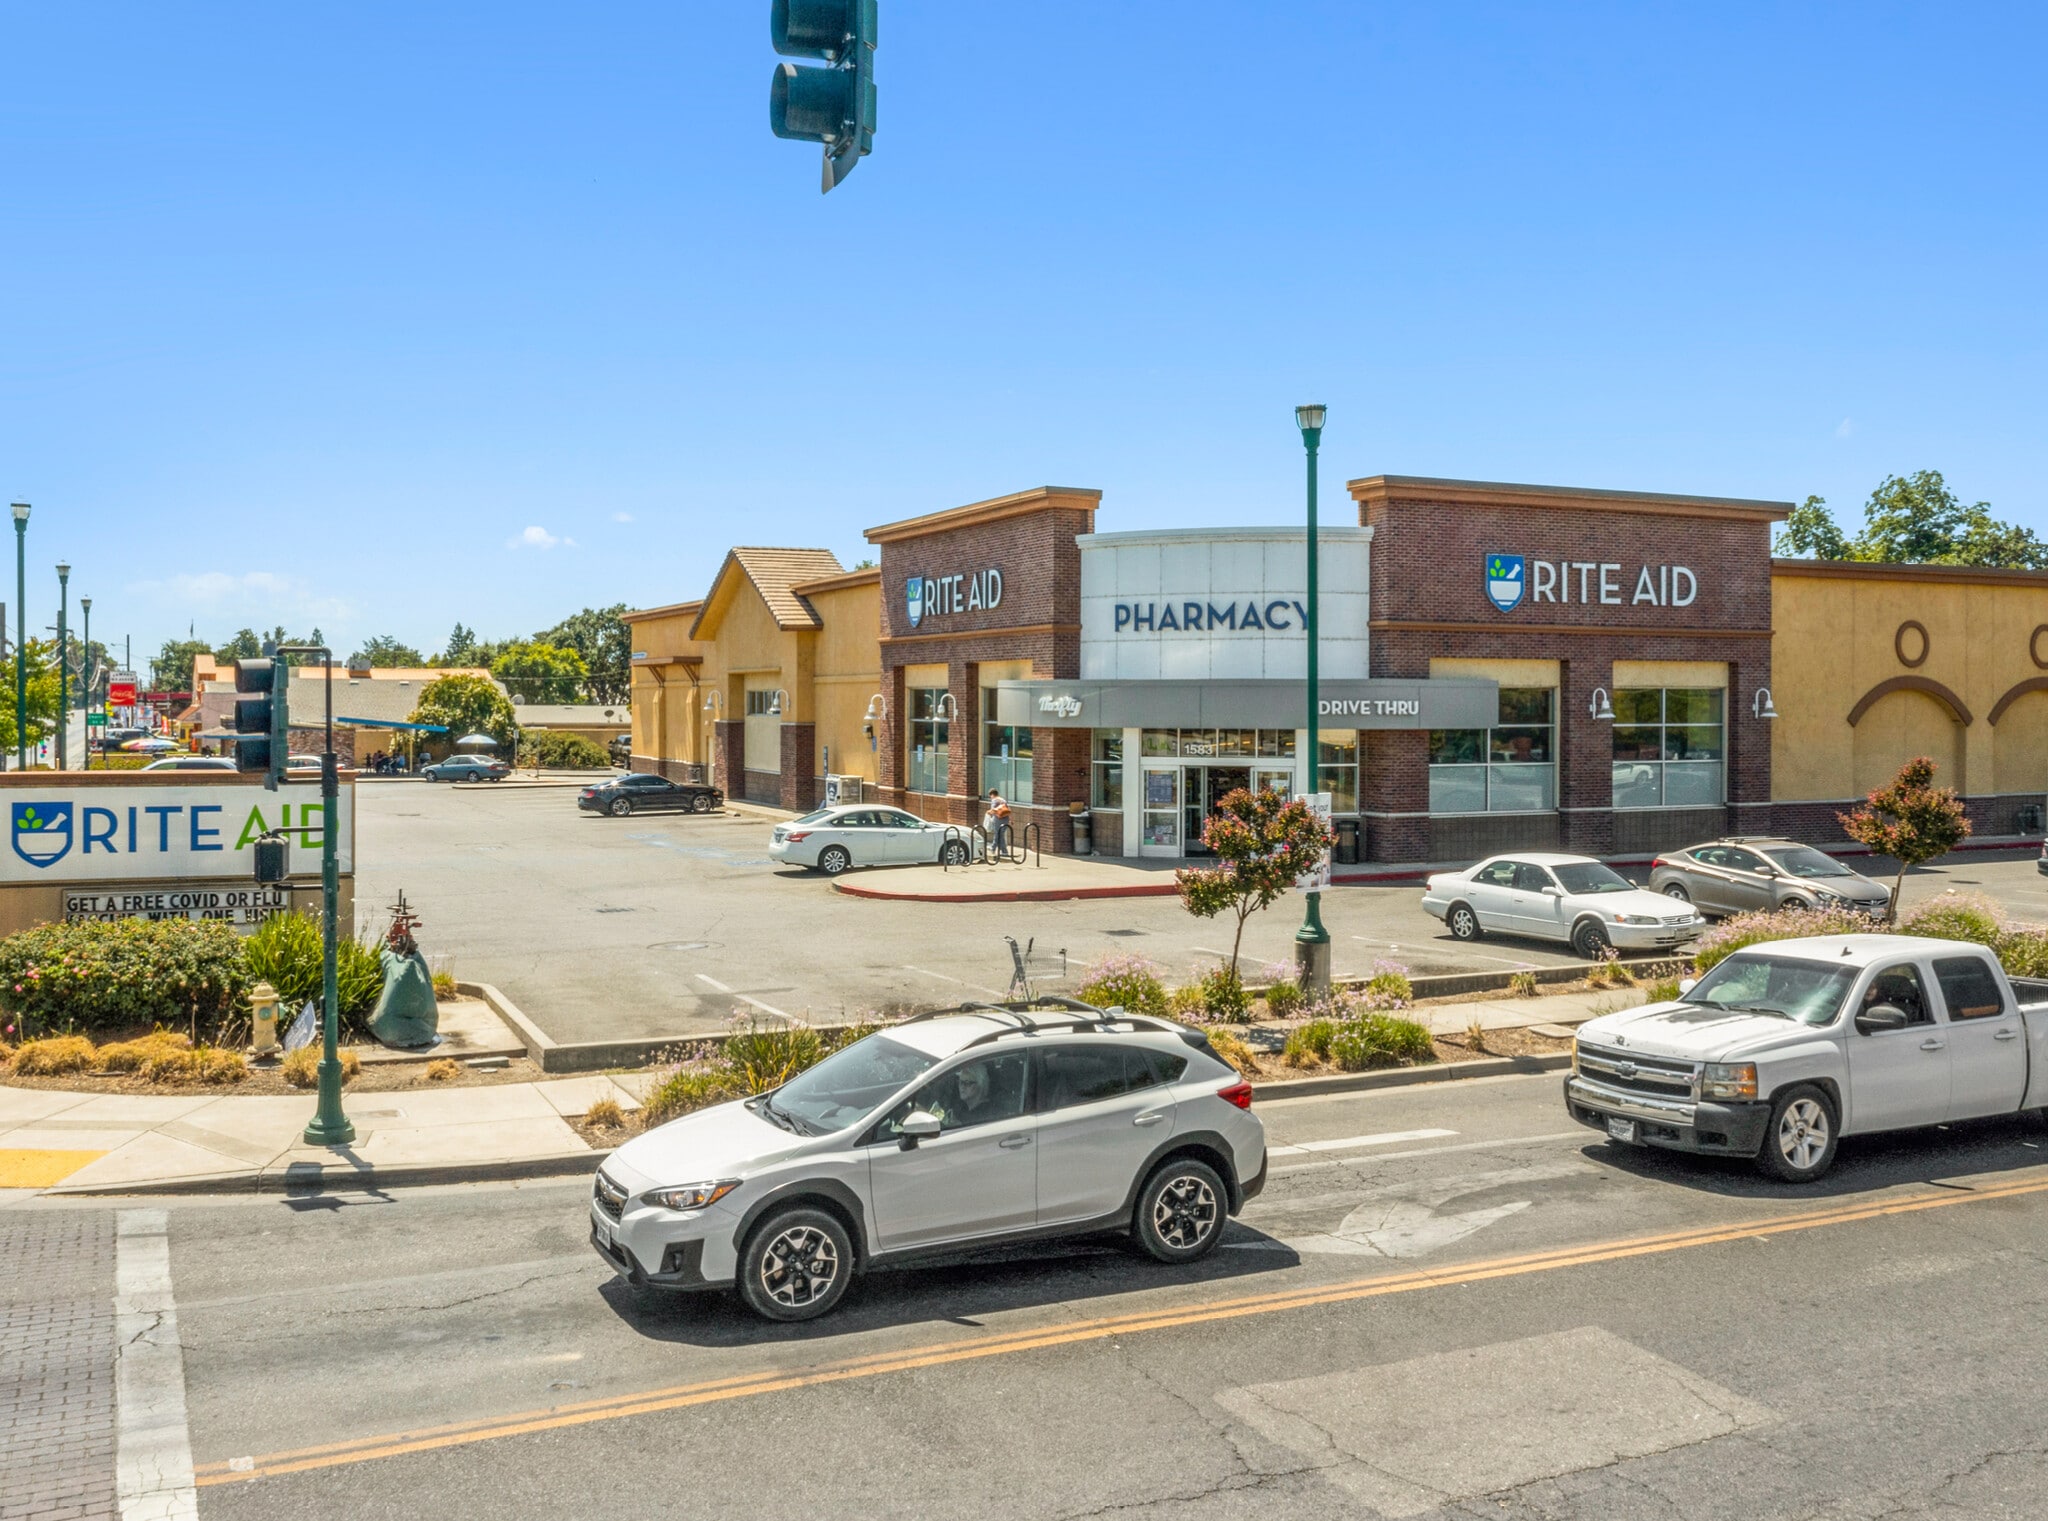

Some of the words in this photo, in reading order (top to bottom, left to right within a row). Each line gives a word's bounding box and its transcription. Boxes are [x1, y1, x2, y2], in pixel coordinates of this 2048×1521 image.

[925, 574, 964, 617] RITE
[968, 569, 1003, 611] AID
[1533, 561, 1622, 604] RITE
[1632, 565, 1698, 607] AID
[1114, 600, 1309, 633] PHARMACY
[1318, 699, 1371, 716] DRIVE
[1373, 699, 1419, 716] THRU
[1184, 743, 1214, 756] 1583
[82, 805, 224, 854] RITE
[234, 803, 339, 851] AID
[67, 897, 99, 912] GET
[106, 896, 117, 912] A
[122, 894, 164, 911] FREE
[169, 893, 220, 909] COVID
[226, 892, 248, 907] OR
[253, 891, 282, 906] FLU
